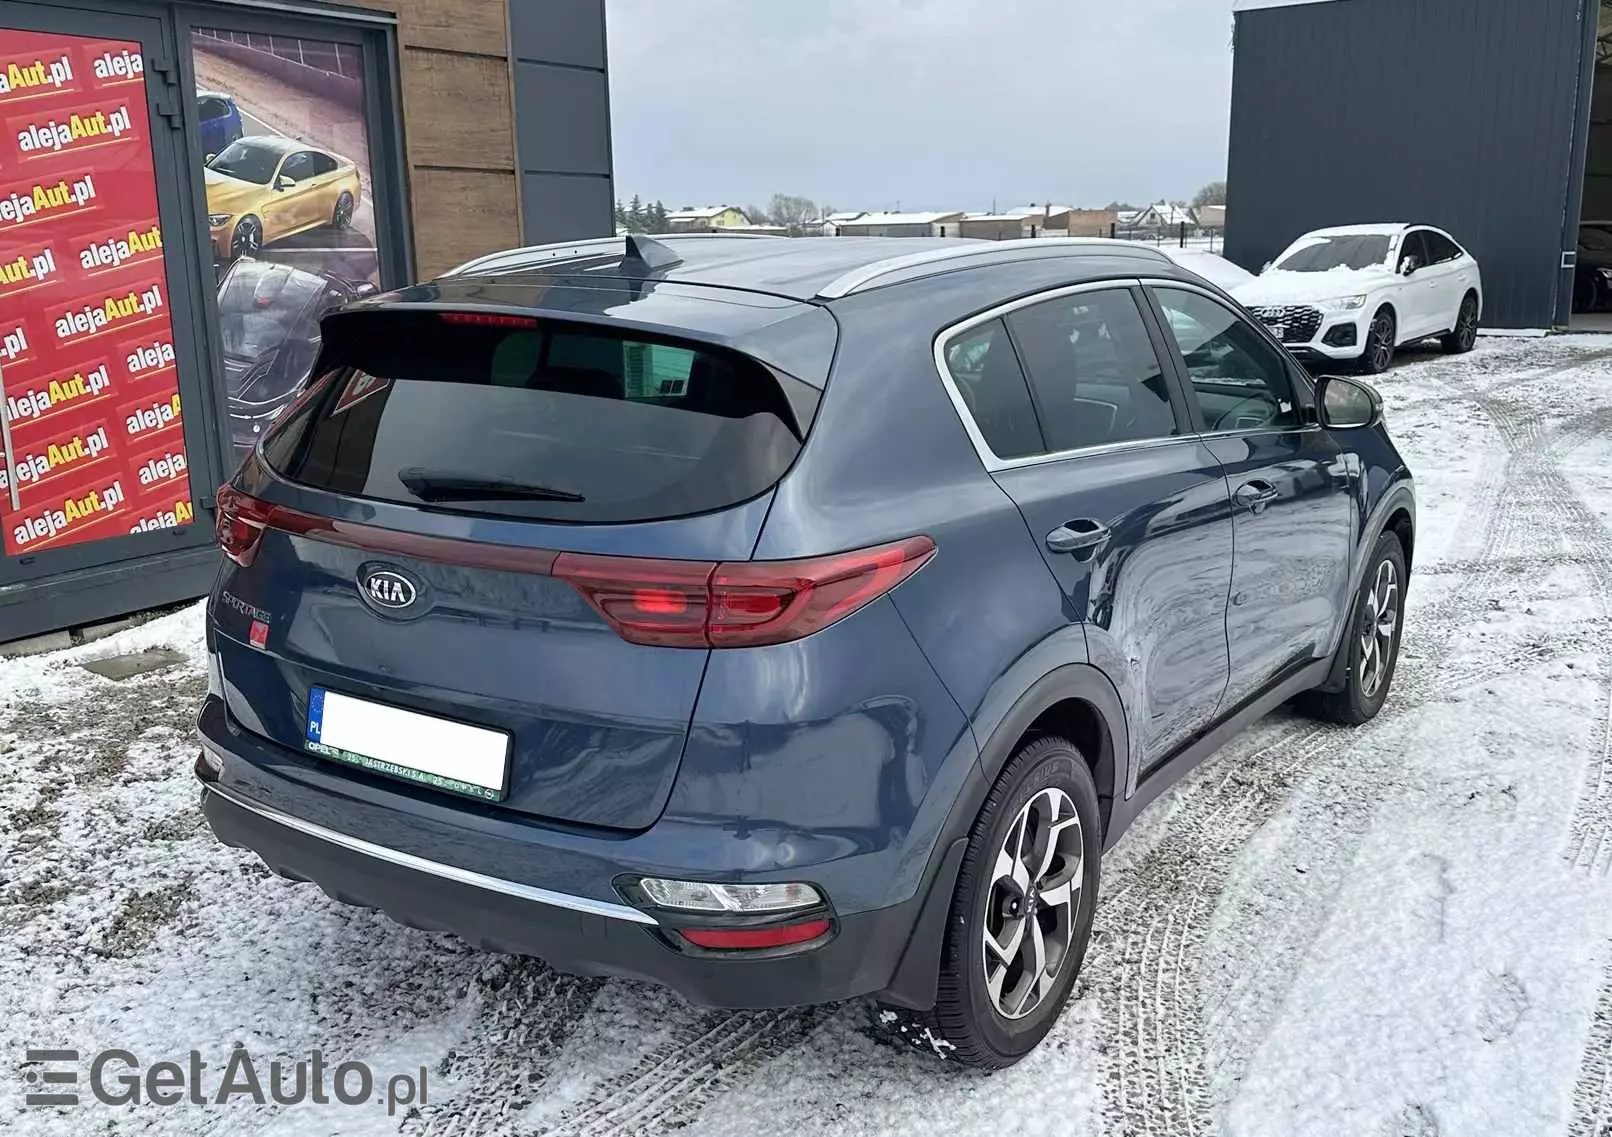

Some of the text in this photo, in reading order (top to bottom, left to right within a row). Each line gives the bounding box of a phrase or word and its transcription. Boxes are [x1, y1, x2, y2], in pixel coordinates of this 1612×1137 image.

[18, 106, 131, 151] alejaAut.pl
[0, 175, 96, 222] ejaAut.pl
[55, 284, 163, 338] alejaAut.pl
[127, 341, 175, 372] aleja
[14, 481, 124, 545] alejaAut.pl
[222, 591, 271, 623] SPORTAGE
[370, 577, 406, 602] KIA
[310, 720, 321, 735] PL
